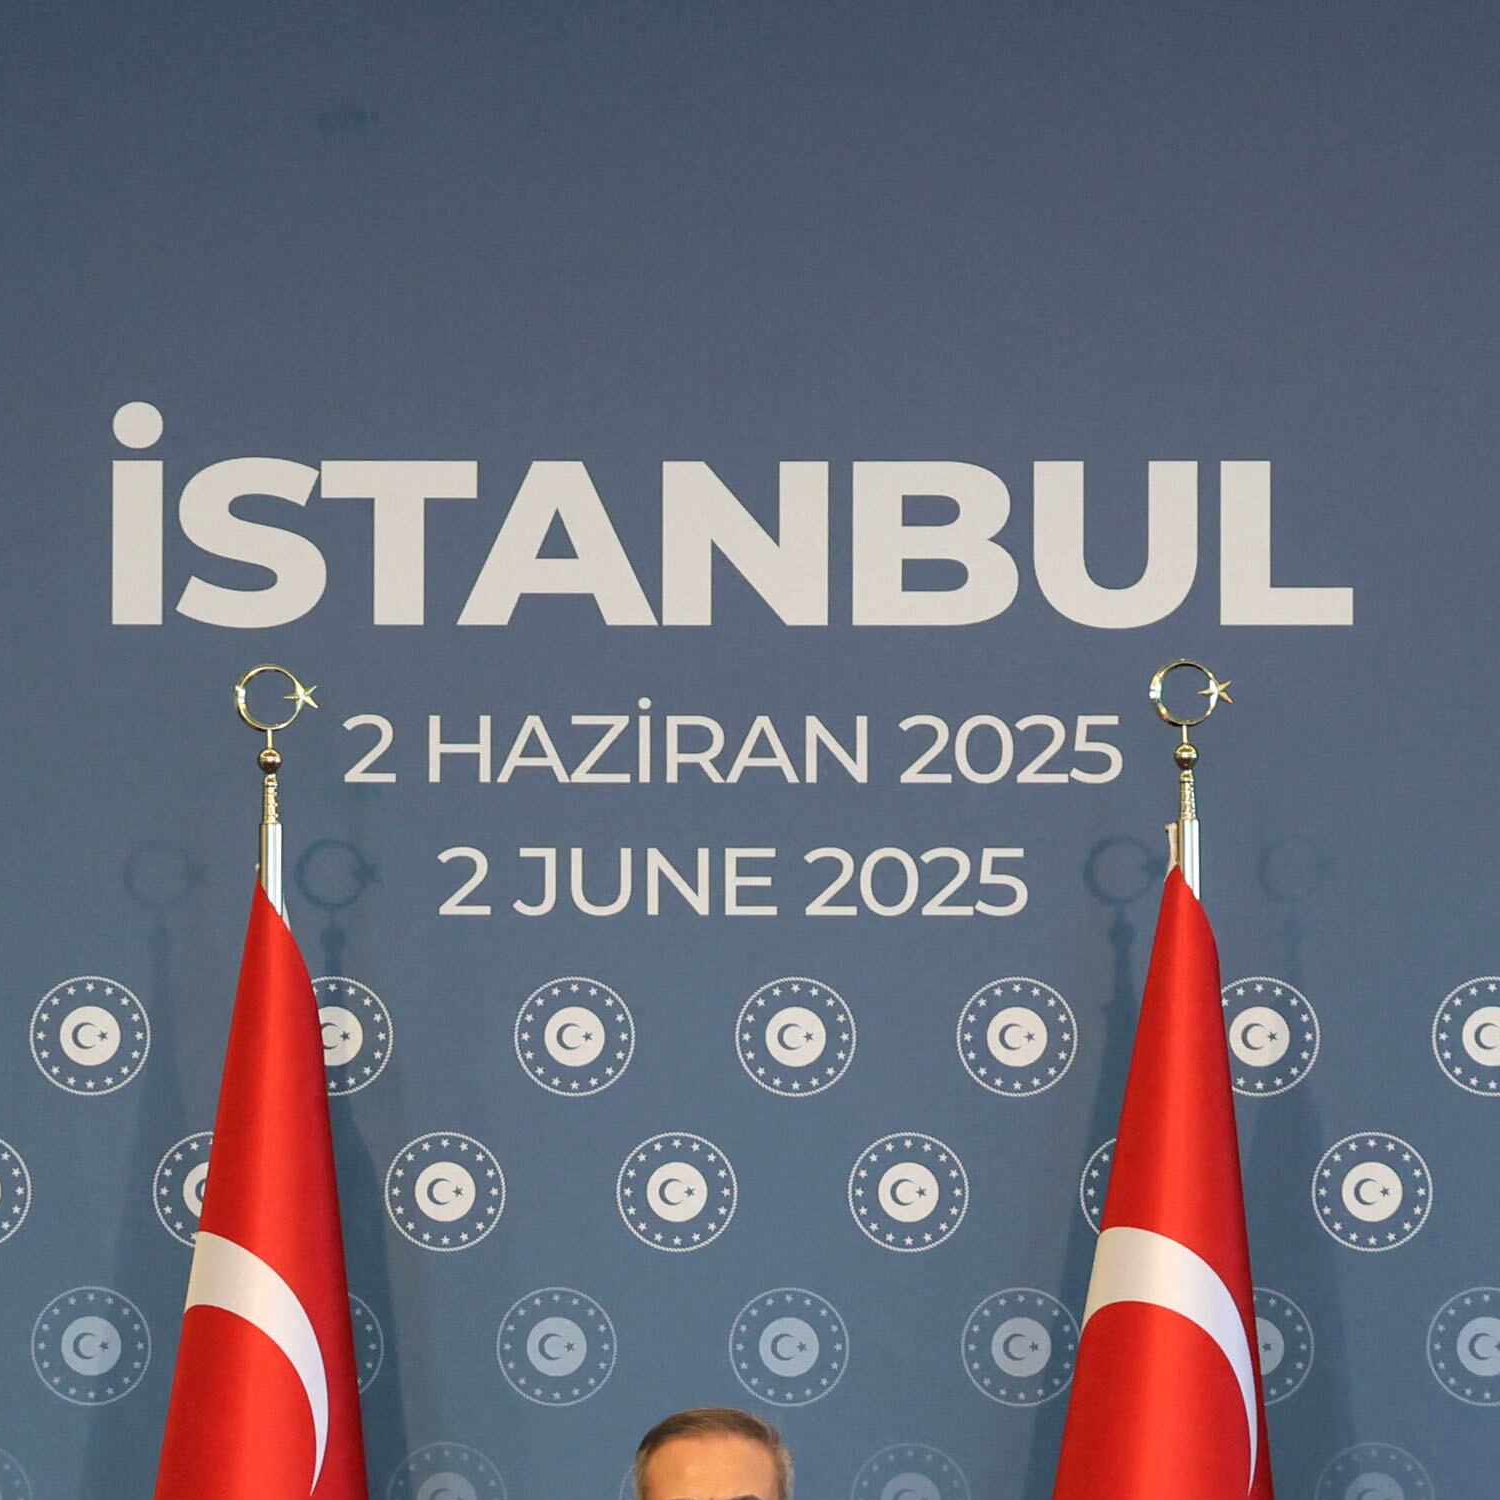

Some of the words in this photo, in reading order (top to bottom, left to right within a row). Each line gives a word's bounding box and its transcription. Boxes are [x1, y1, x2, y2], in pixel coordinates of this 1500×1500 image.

[112, 401, 1354, 629] İSTANBUL
[343, 714, 397, 783] 2
[428, 697, 868, 784] HAZİRAN
[899, 714, 1123, 784] 2025
[438, 847, 492, 916] 2
[513, 847, 778, 917] JUNE
[804, 847, 1028, 917] 2025
